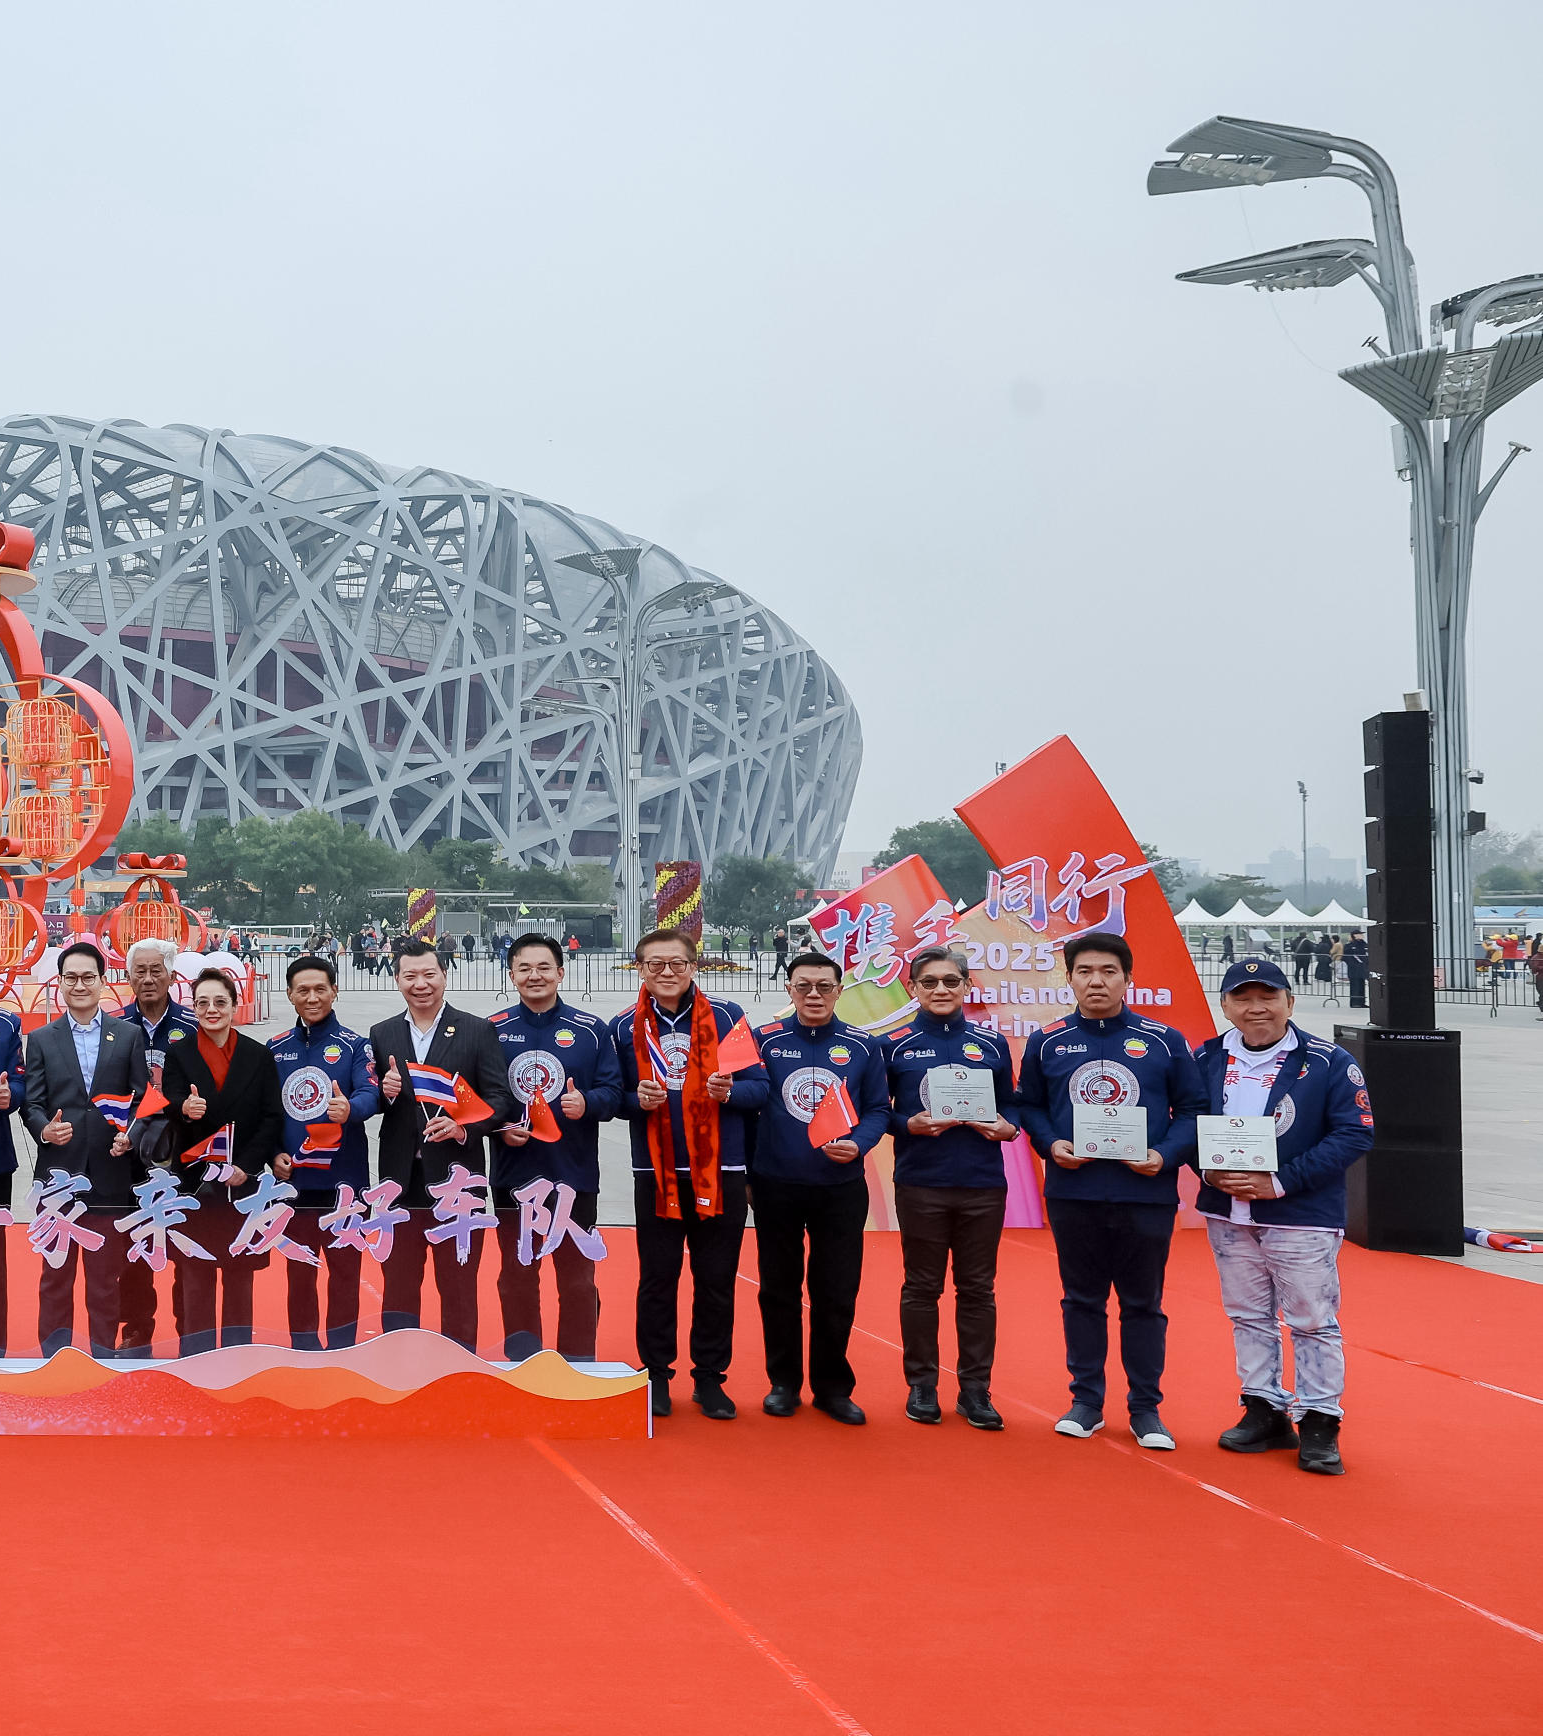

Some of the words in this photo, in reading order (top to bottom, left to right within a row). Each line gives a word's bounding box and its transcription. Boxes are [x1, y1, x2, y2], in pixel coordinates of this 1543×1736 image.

[820, 899, 970, 990] 携手
[985, 852, 1171, 952] 同行
[965, 942, 1056, 971] 2025
